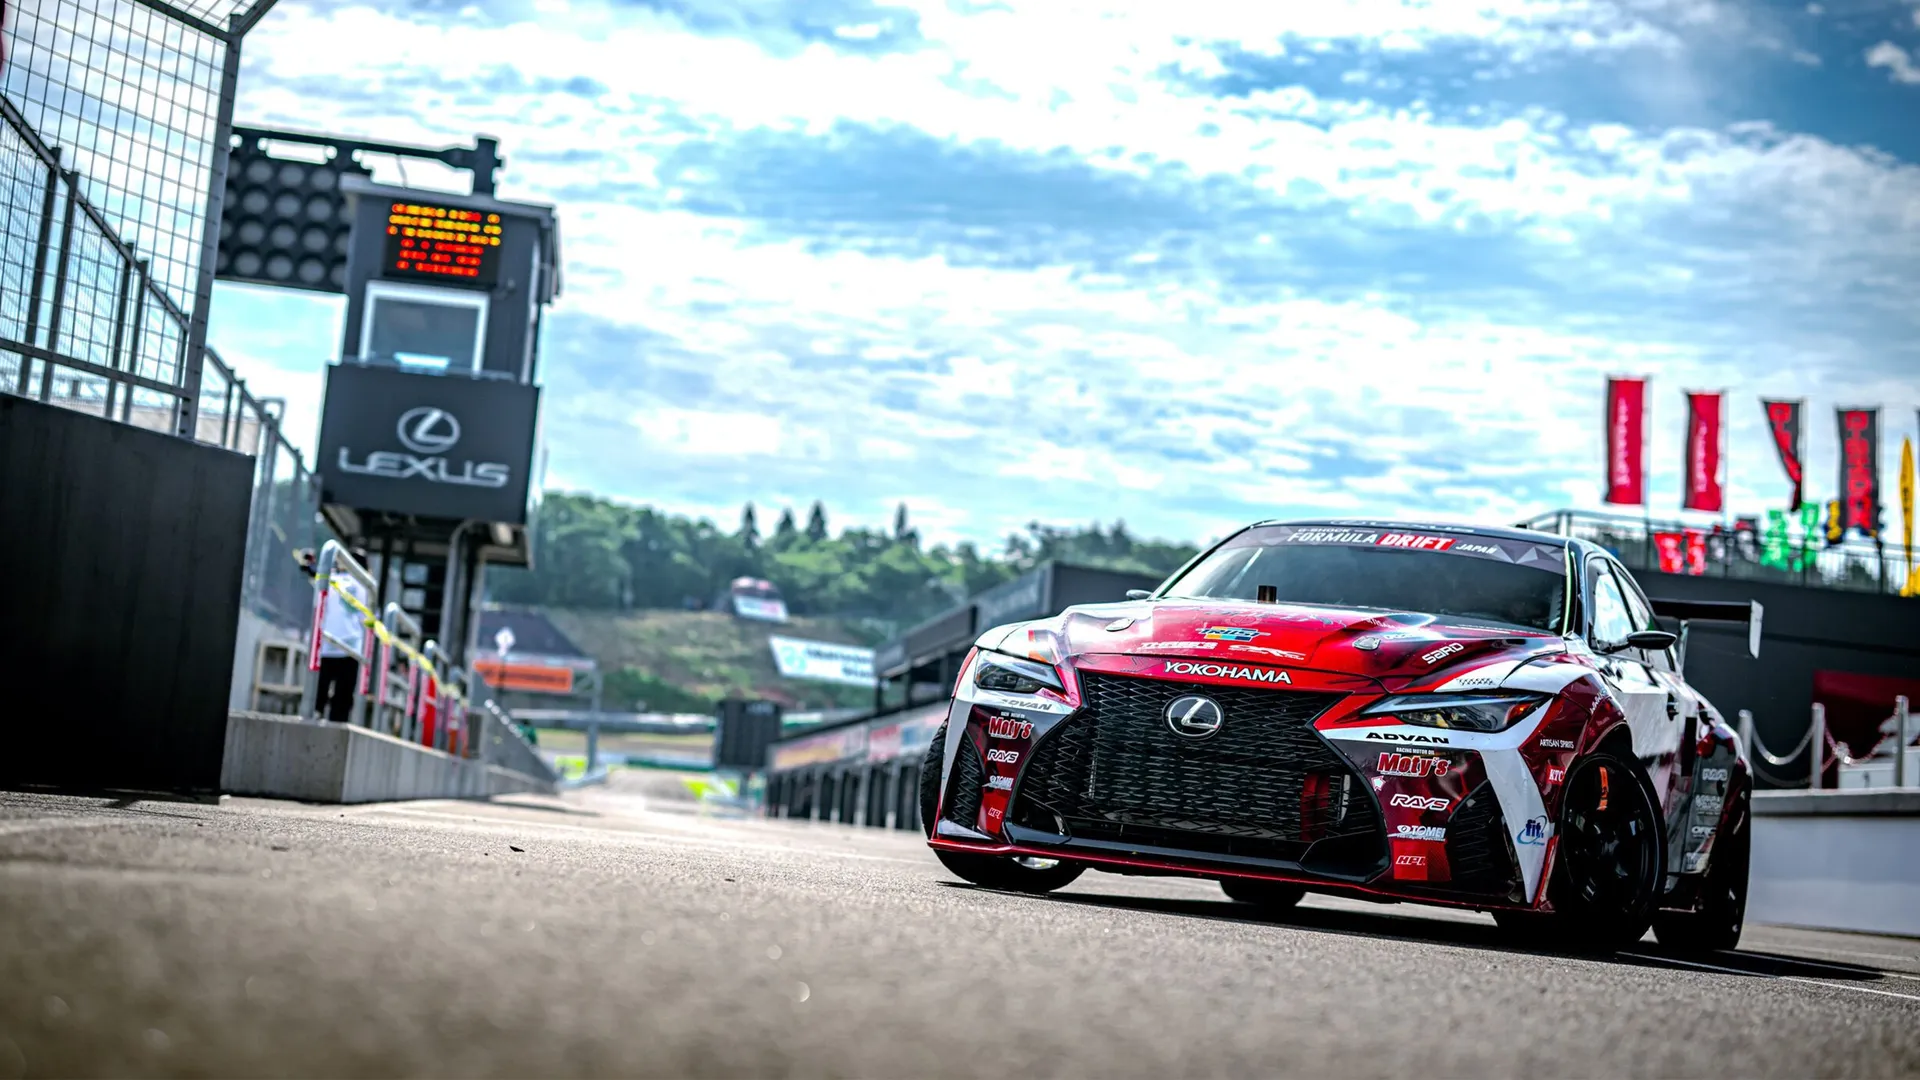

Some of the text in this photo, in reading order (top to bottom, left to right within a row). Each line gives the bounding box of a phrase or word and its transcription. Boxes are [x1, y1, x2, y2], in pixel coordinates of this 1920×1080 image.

[338, 446, 510, 488] LEXUS
[1287, 532, 1497, 554] FORMULA DRIFT JAPAN
[1164, 661, 1292, 684] YOKOHAMA
[989, 716, 1033, 739] Moty's
[1366, 732, 1449, 744] ADVAN
[1540, 739, 1574, 749] ARTISAN SPIRITS
[987, 749, 1018, 763] RAYS
[1377, 752, 1450, 777] Moty's
[1549, 769, 1564, 782] KTC
[1390, 794, 1450, 811] RAYS
[1411, 825, 1446, 838] TOMEI
